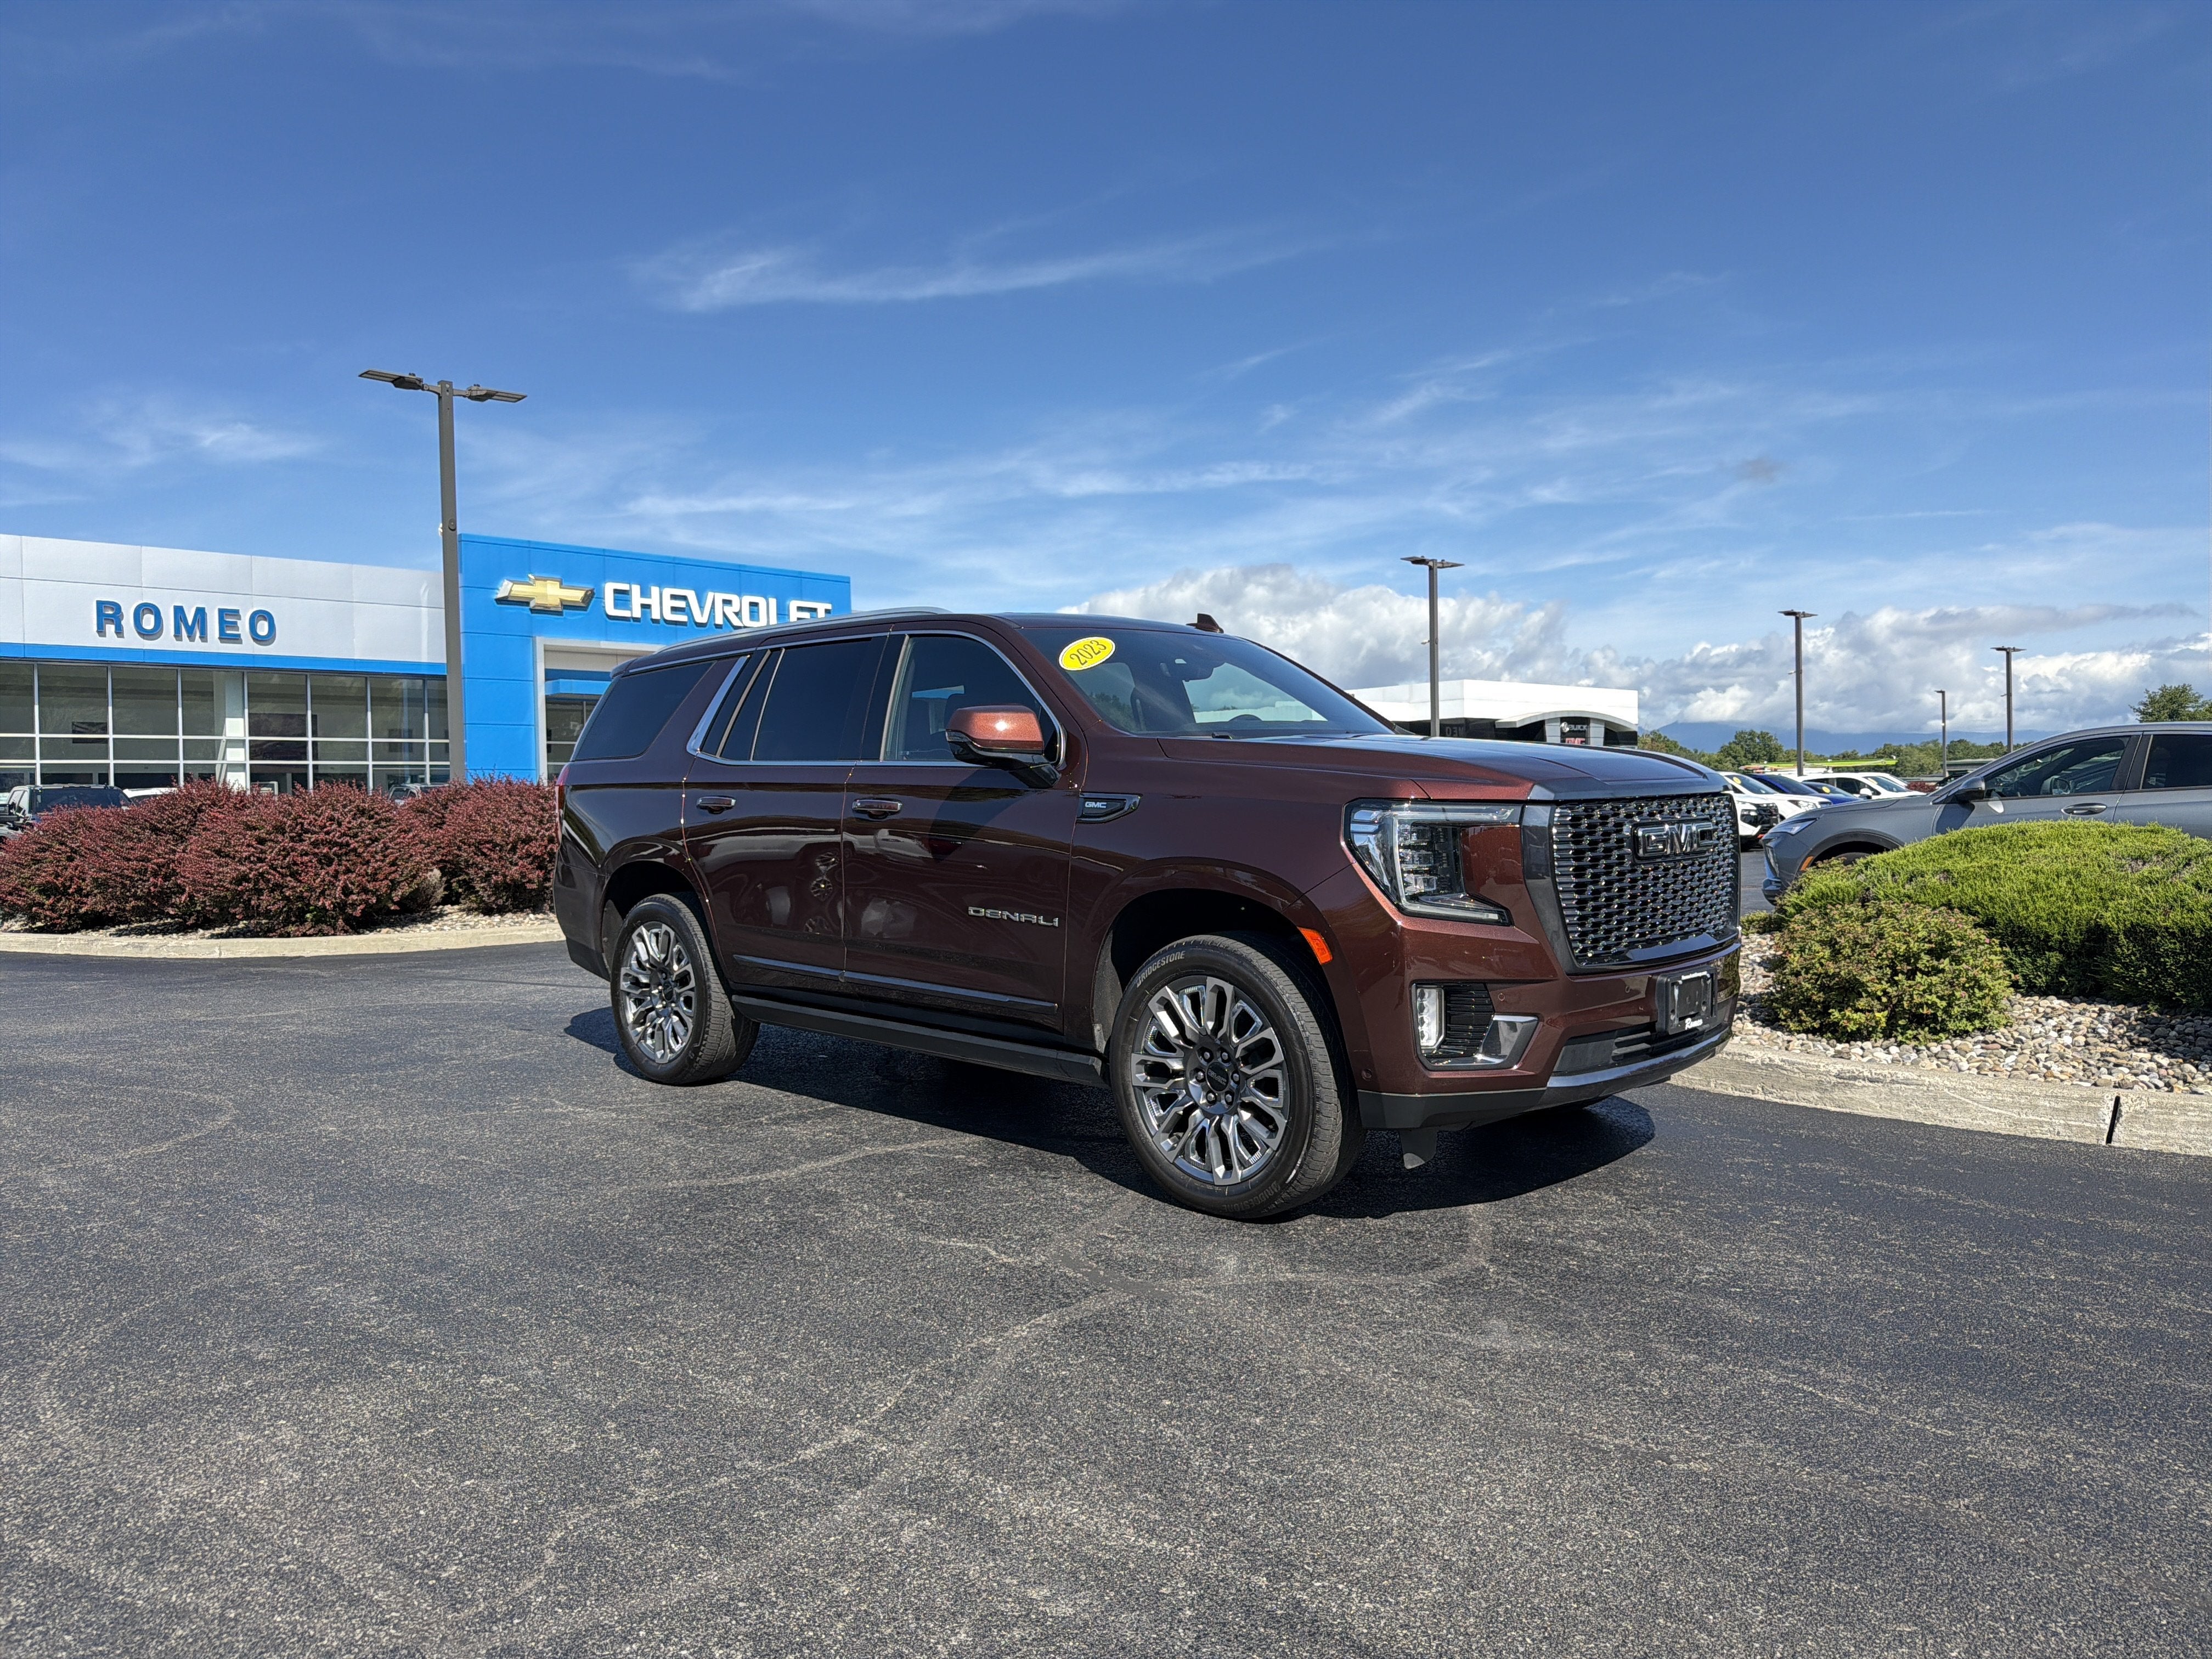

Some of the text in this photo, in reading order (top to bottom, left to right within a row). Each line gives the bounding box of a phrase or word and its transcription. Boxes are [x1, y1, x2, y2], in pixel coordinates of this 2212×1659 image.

[95, 600, 276, 642] ROMEO
[1069, 640, 1107, 665] 2023
[1638, 822, 1713, 857] GMC
[968, 906, 1059, 927] DENALI
[1136, 950, 1186, 988] BRIDGESTONE
[1207, 1069, 1227, 1086] GMC
